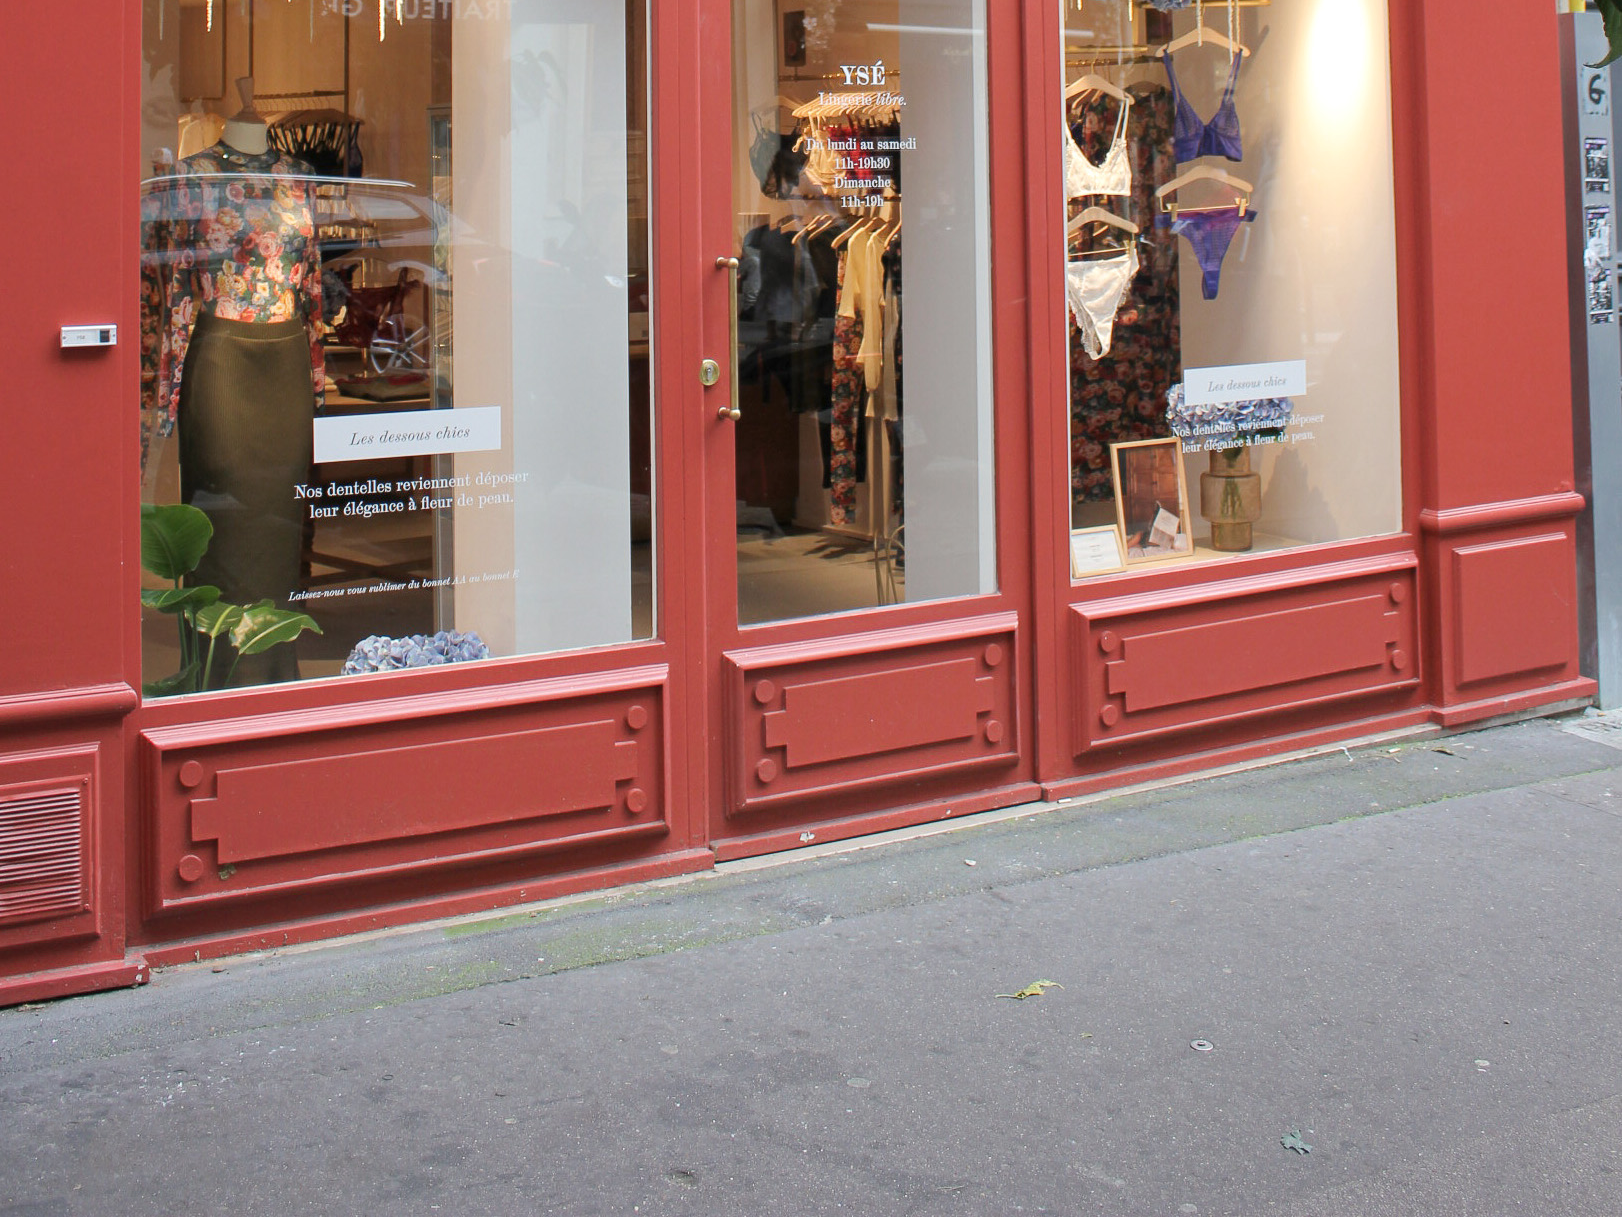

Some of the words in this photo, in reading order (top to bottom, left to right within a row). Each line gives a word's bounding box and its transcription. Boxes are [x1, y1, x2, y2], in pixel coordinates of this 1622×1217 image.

[840, 60, 886, 85] YSÉ
[818, 91, 872, 109] Lingerie
[875, 92, 907, 106] libre.
[806, 138, 824, 151] Du
[827, 138, 857, 150] lundi
[860, 140, 874, 150] au
[877, 137, 917, 150] samedi
[834, 157, 891, 170] 11h-19h30
[834, 176, 891, 189] Dimanche
[840, 195, 884, 208] 11h-19h
[1207, 381, 1224, 393] Les
[1227, 379, 1262, 391] dessous
[1263, 376, 1287, 387] chics
[1171, 426, 1190, 438] Nos
[1192, 422, 1236, 436] dentelles
[1238, 416, 1287, 432] reviennent
[1289, 413, 1325, 428] déposer
[350, 432, 375, 446] Les
[379, 430, 431, 443] dessous
[436, 426, 471, 440] chics
[1182, 442, 1202, 454] leur
[1203, 438, 1244, 453] élégance
[1246, 435, 1252, 447] à
[1254, 434, 1276, 446] fleur
[1278, 431, 1289, 443] de
[293, 484, 323, 499] Nos
[326, 479, 392, 497] dentelles
[396, 473, 471, 492] reviennent
[475, 471, 529, 488] déposer
[309, 505, 339, 519] leur
[343, 500, 404, 518] élégance
[408, 497, 417, 511] à
[421, 495, 453, 510] fleur
[457, 493, 474, 507] de
[478, 493, 514, 509] peau.
[288, 589, 345, 602] Laissez-nous
[347, 586, 366, 596] vous
[368, 582, 406, 594] sublimer
[408, 579, 420, 590] du
[422, 576, 451, 588] bonnet
